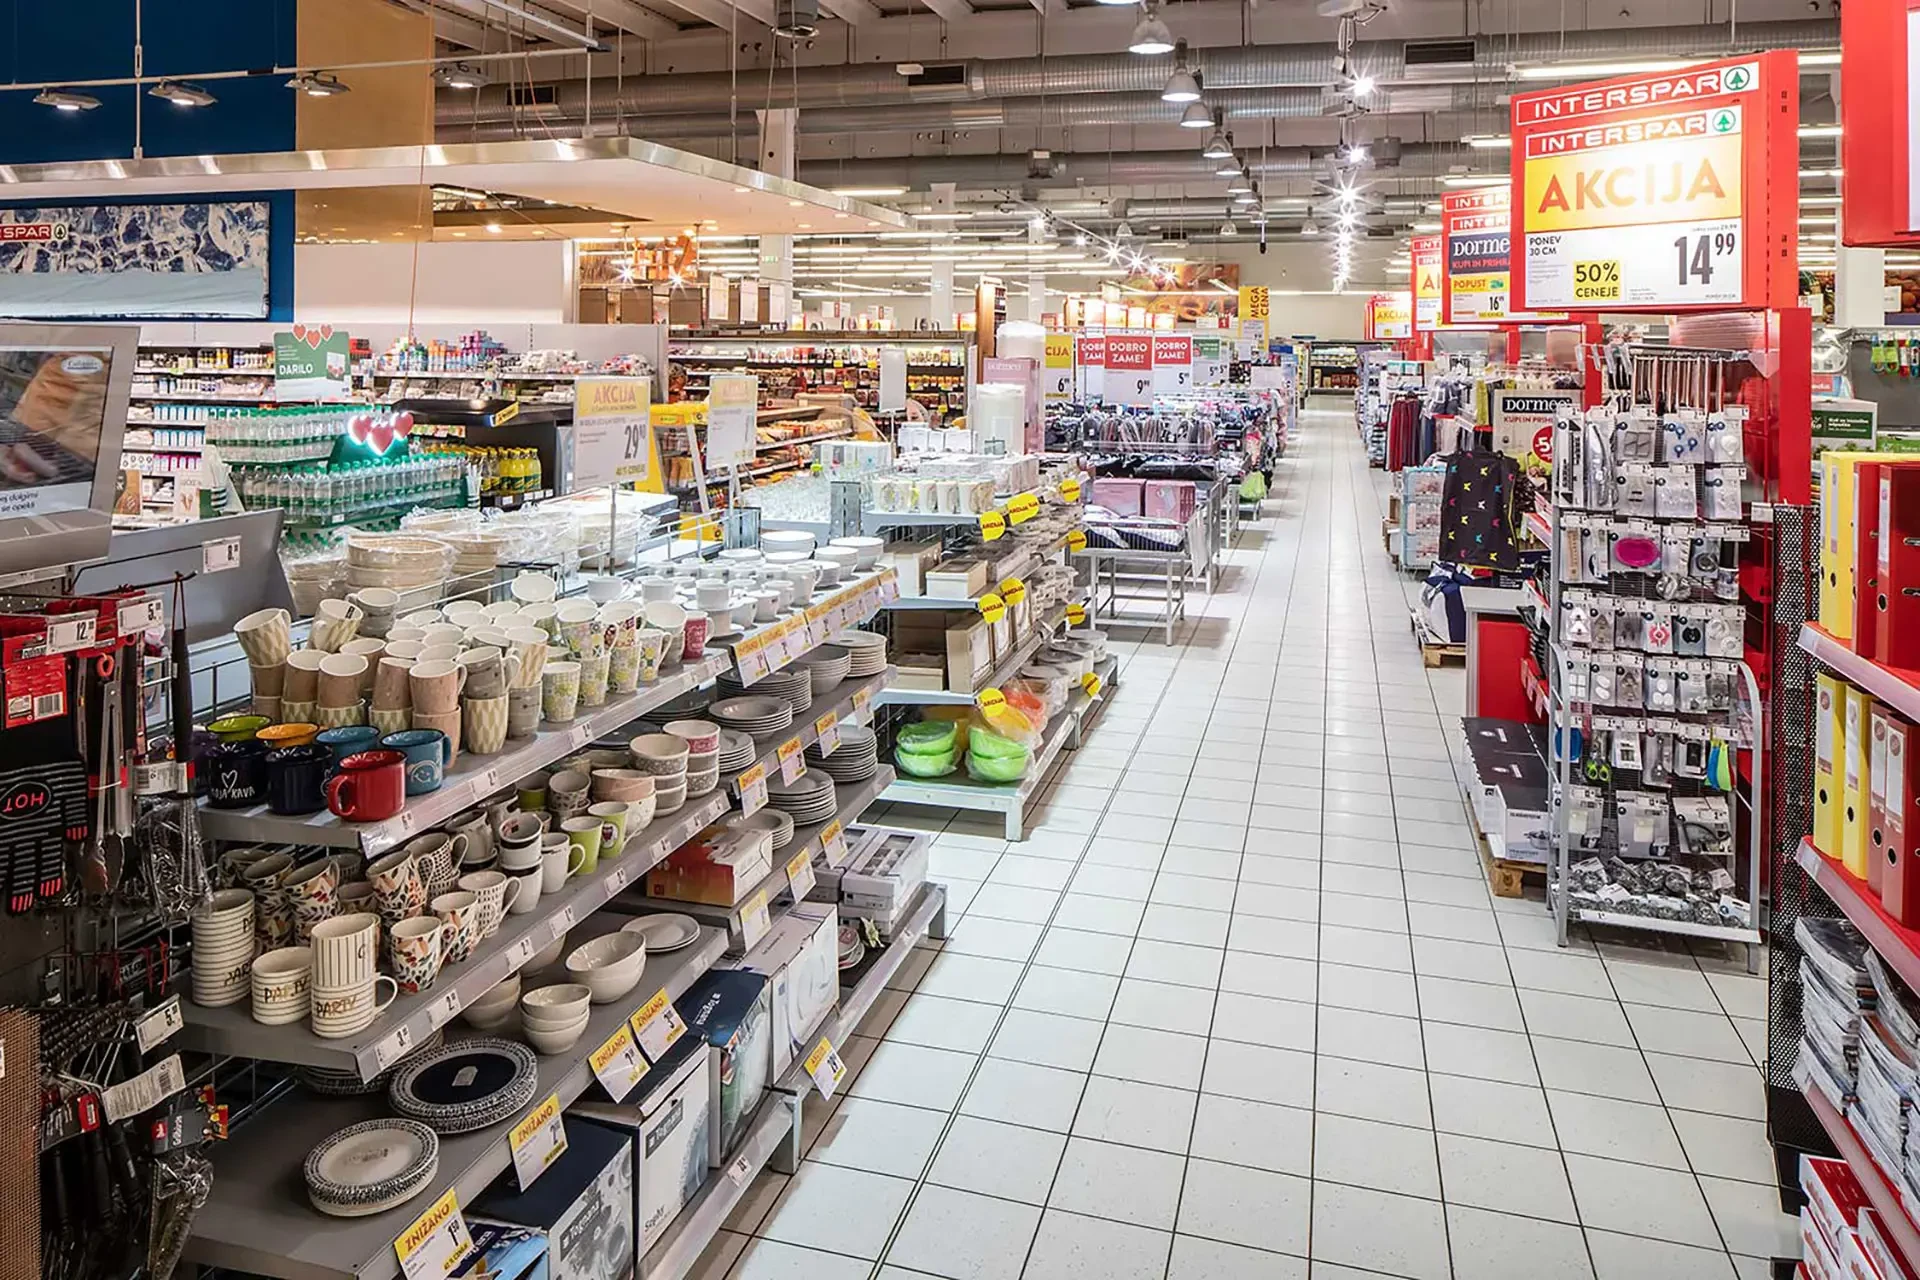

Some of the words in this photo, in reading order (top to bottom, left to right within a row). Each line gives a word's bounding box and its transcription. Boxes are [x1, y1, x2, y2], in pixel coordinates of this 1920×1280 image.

[1535, 75, 1720, 119] INTERSPAR
[1542, 116, 1706, 153] INTERSPAR
[1537, 158, 1727, 214] AKCIJA
[0, 226, 50, 238] SPAR
[1529, 236, 1562, 246] PONEV
[1542, 247, 1557, 255] CM
[1575, 262, 1618, 283] 50%
[1454, 280, 1486, 288] POPUST
[1575, 287, 1618, 298] CENEJE
[1251, 287, 1259, 318] MEGA
[1260, 287, 1269, 316] CENA
[1109, 342, 1148, 352] DOBRO
[1155, 342, 1188, 350] DOBRO
[1157, 351, 1185, 359] ZAME!
[1112, 353, 1145, 363] ZAME!
[279, 363, 313, 375] DARILO
[594, 384, 635, 404] AKCIJA
[2, 792, 44, 812] HOT
[596, 1035, 626, 1067] ZNIŽANO
[518, 1105, 553, 1143] ZNIŽANO
[405, 1203, 451, 1252] ZNIŽANO
